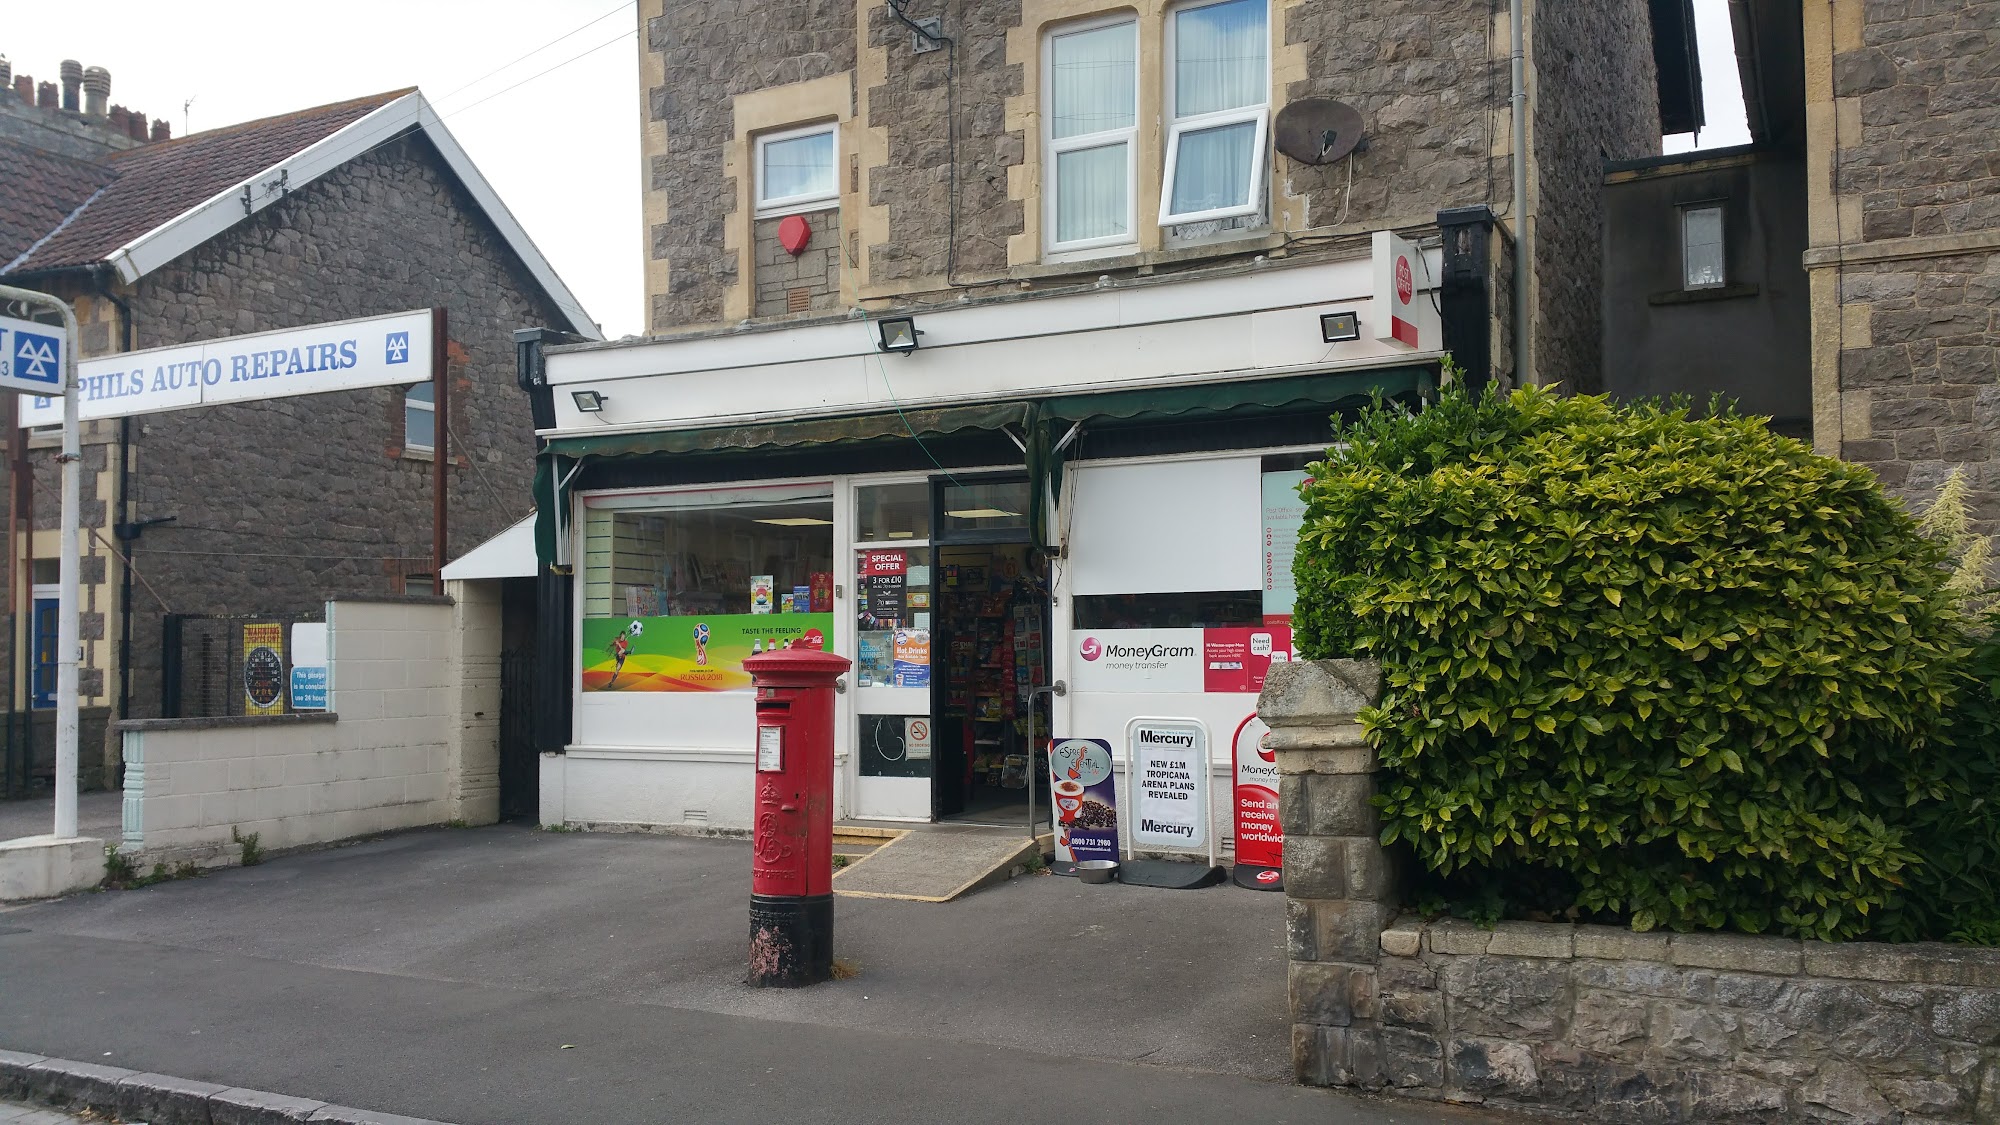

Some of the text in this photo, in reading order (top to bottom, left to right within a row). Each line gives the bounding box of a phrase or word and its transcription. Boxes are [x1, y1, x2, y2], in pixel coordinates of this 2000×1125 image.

[1400, 264, 1410, 280] POST
[1396, 277, 1411, 295] OFFICE
[78, 340, 357, 401] PHILS AUTO REPAIRS
[872, 554, 903, 562] SPECIAL
[1106, 644, 1194, 660] MoneyGram
[1106, 660, 1168, 670] money transfer
[1140, 730, 1193, 747] Mercury
[1150, 760, 1186, 769] NEW £1M
[1146, 770, 1190, 779] TROPICANA
[1142, 780, 1194, 790] ARENA PLANS
[1148, 790, 1188, 800] REVEALED
[1241, 799, 1264, 808] Send
[1241, 810, 1274, 820] receive
[1142, 819, 1194, 837] Mercury
[1241, 822, 1273, 832] money
